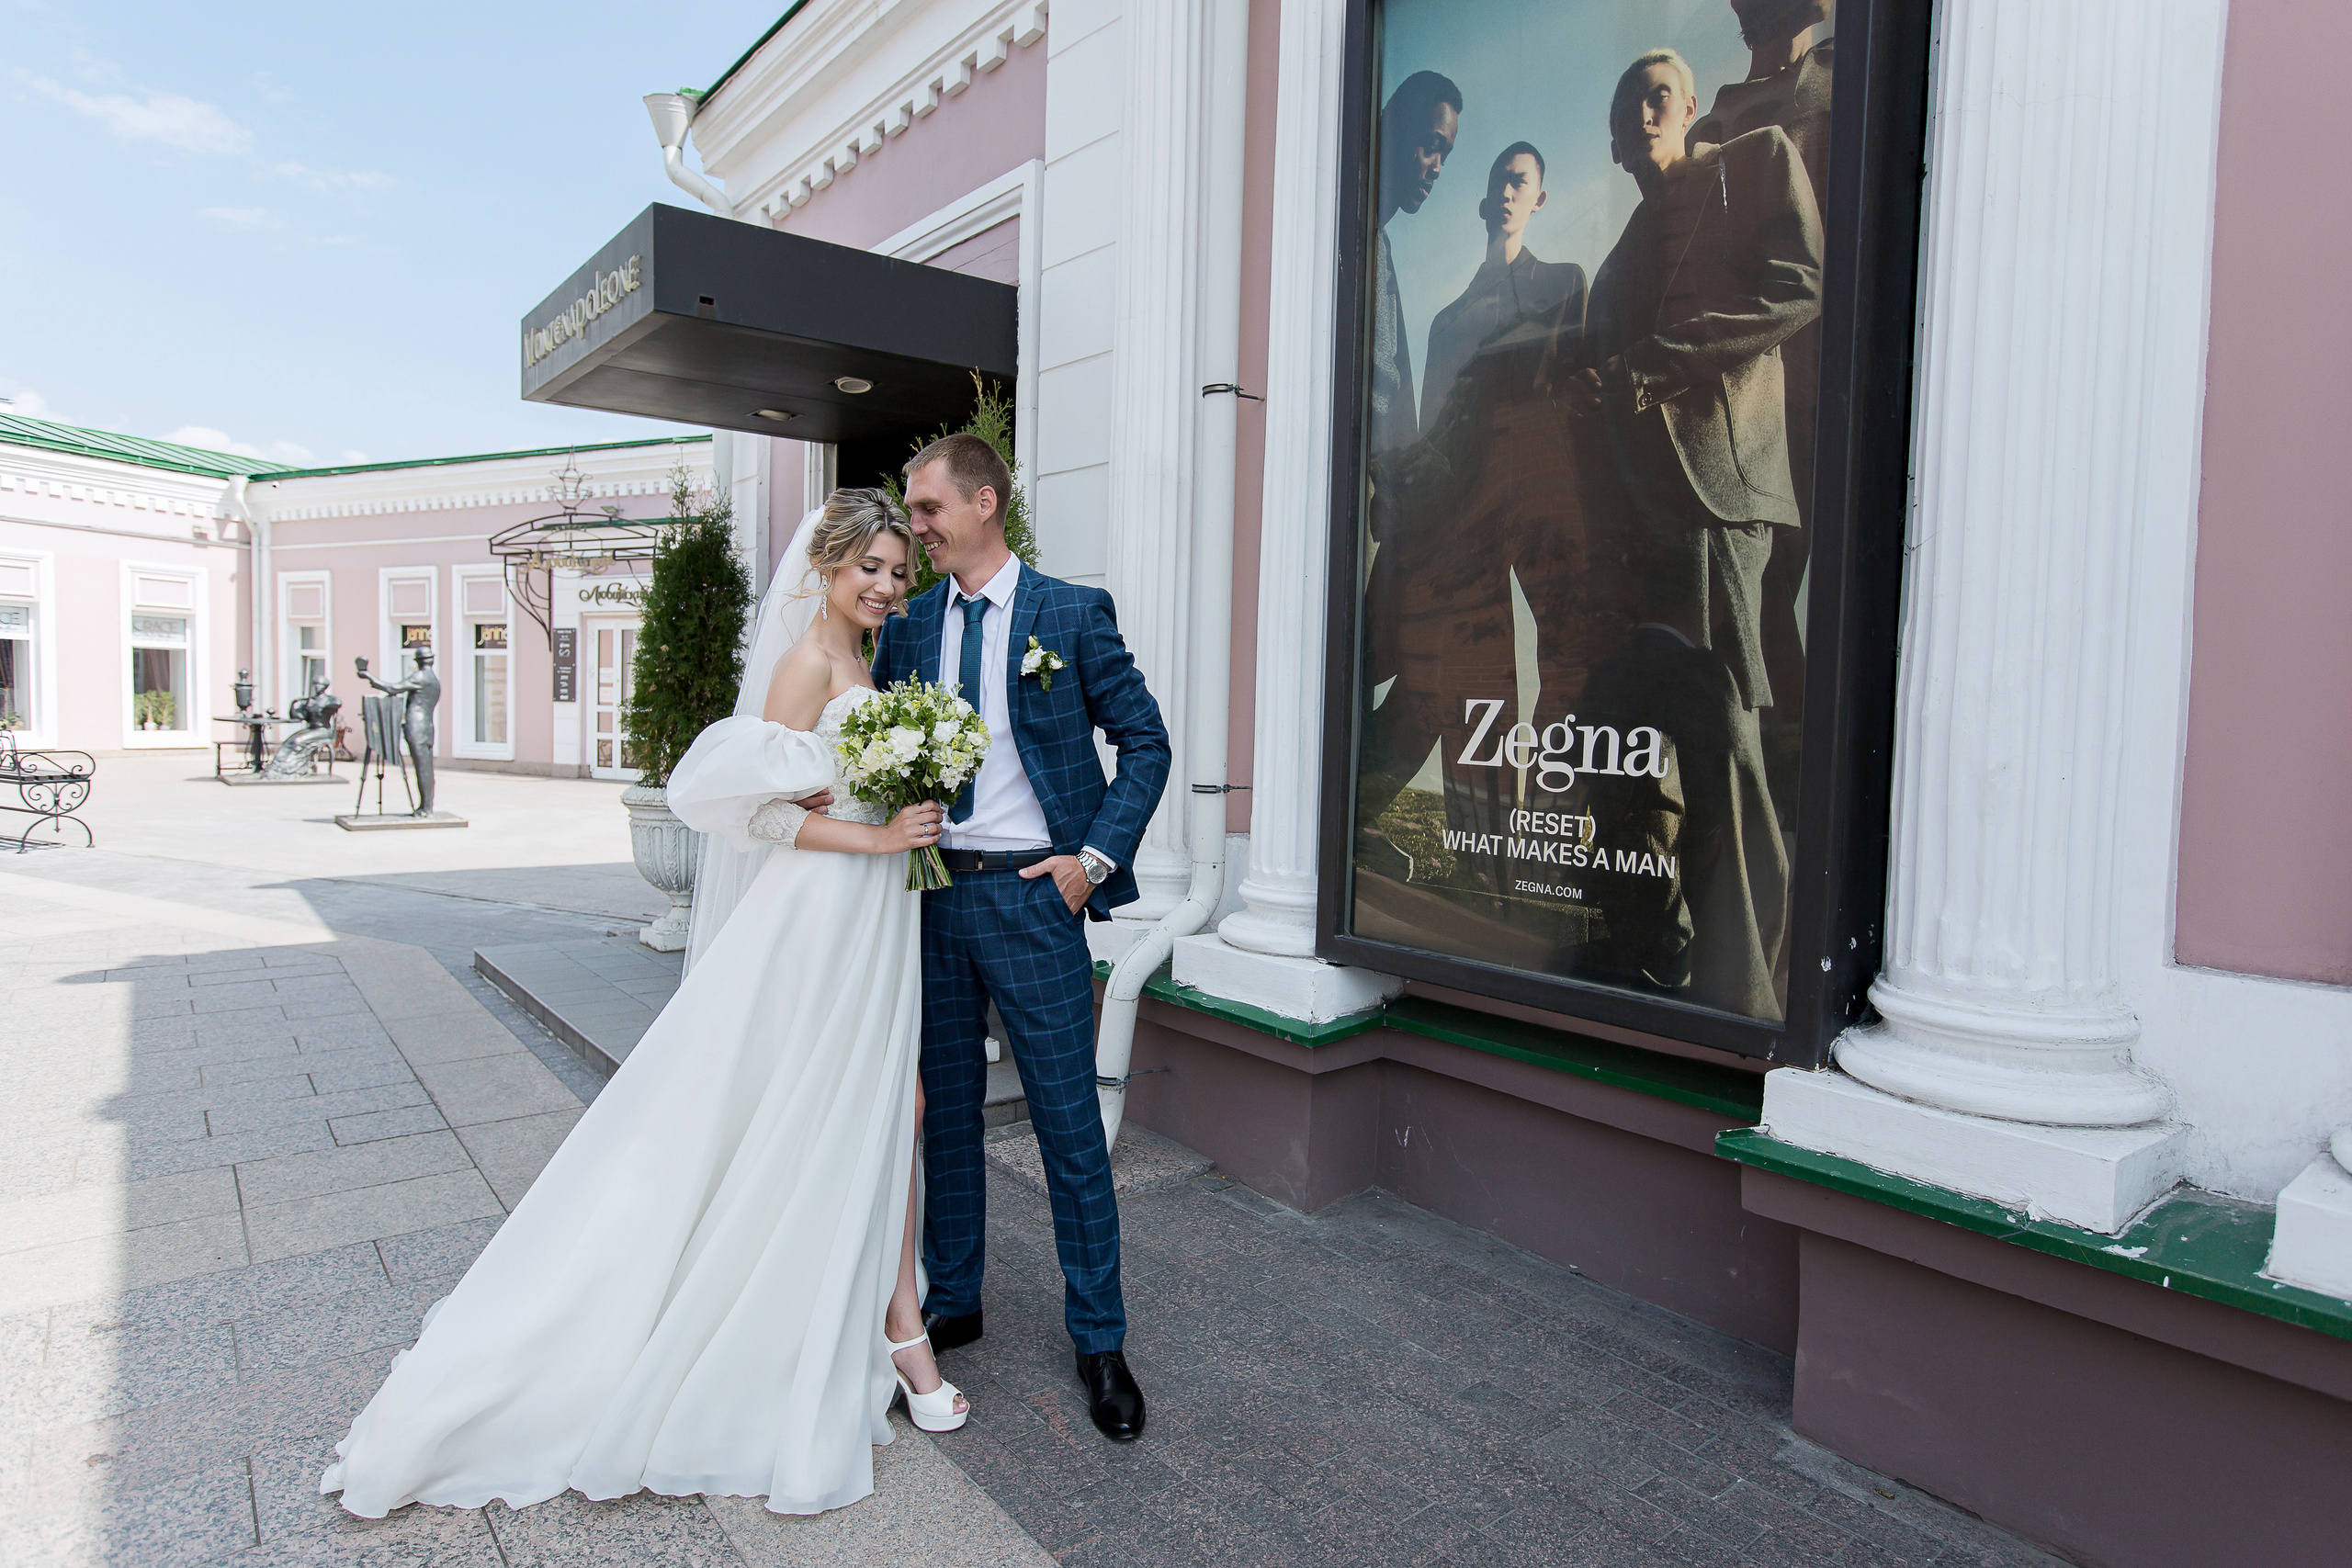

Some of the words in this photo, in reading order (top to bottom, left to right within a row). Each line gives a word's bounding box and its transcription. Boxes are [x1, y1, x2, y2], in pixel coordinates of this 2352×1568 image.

[1457, 698, 1669, 793] Zegna
[1509, 807, 1596, 842] (RESET)
[1442, 829, 1503, 856] WHAT
[1507, 837, 1589, 867] MAKES
[1591, 848, 1610, 871] A
[1615, 850, 1676, 879] MAN
[1515, 879, 1582, 900] ZEGNA.COM
